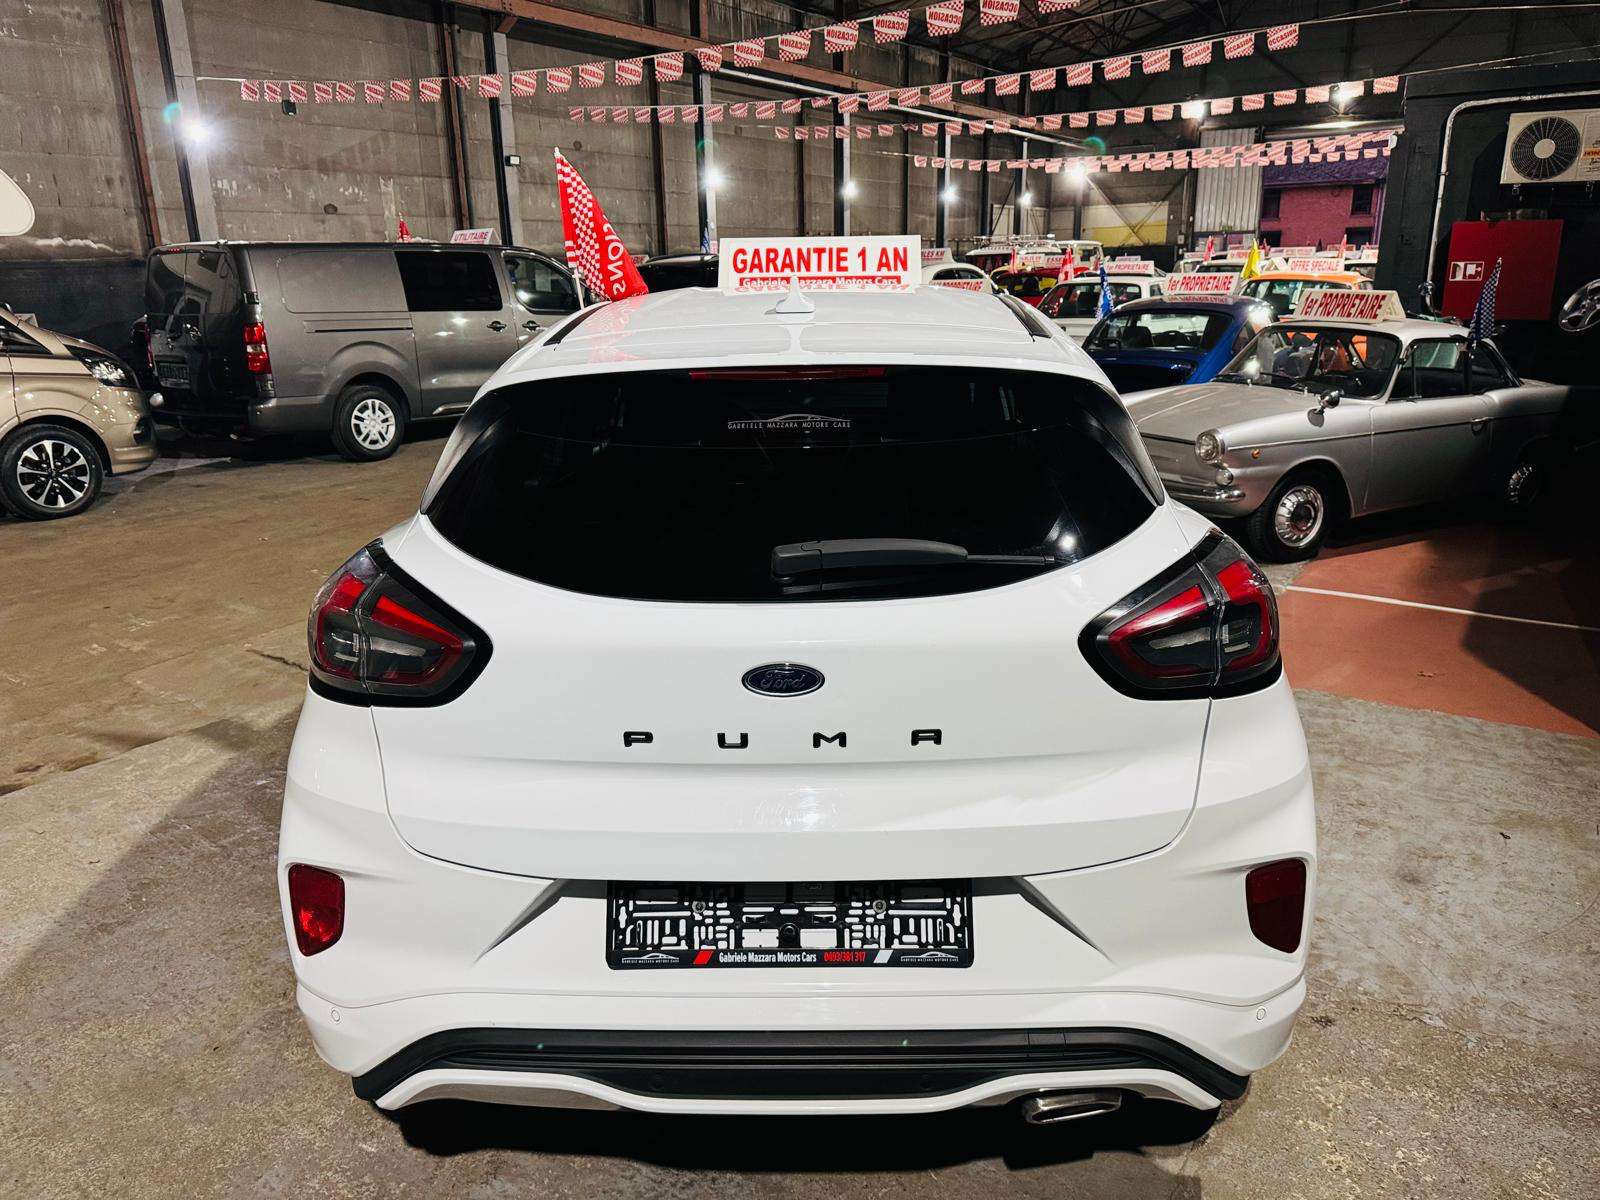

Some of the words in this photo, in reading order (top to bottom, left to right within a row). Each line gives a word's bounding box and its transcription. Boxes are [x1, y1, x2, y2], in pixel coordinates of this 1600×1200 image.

[1269, 29, 1297, 46] OCCASION
[1184, 46, 1210, 61] OCCASION
[1226, 38, 1253, 54] OCCASION
[1105, 60, 1130, 75] OCCASION
[1144, 53, 1169, 69] OCCASION
[733, 247, 849, 273] GARANTIE
[857, 247, 867, 273] 1
[876, 247, 908, 272] AN
[1290, 260, 1310, 272] OFFRE
[743, 278, 787, 286] Gabriele
[836, 277, 872, 286] Motors
[874, 277, 897, 286] Cars
[1167, 276, 1181, 291] 1er
[1180, 275, 1234, 291] PROPRIETAIRE
[1301, 293, 1318, 317] 1er
[1316, 292, 1388, 320] PROPRIETAIRE
[728, 421, 763, 429] GABRIELE
[761, 669, 806, 689] Ford
[623, 729, 942, 749] PUMA
[719, 952, 747, 963] Gabriele
[748, 952, 776, 963] Mazzara
[777, 952, 801, 962] Motors
[801, 952, 817, 962] Cars
